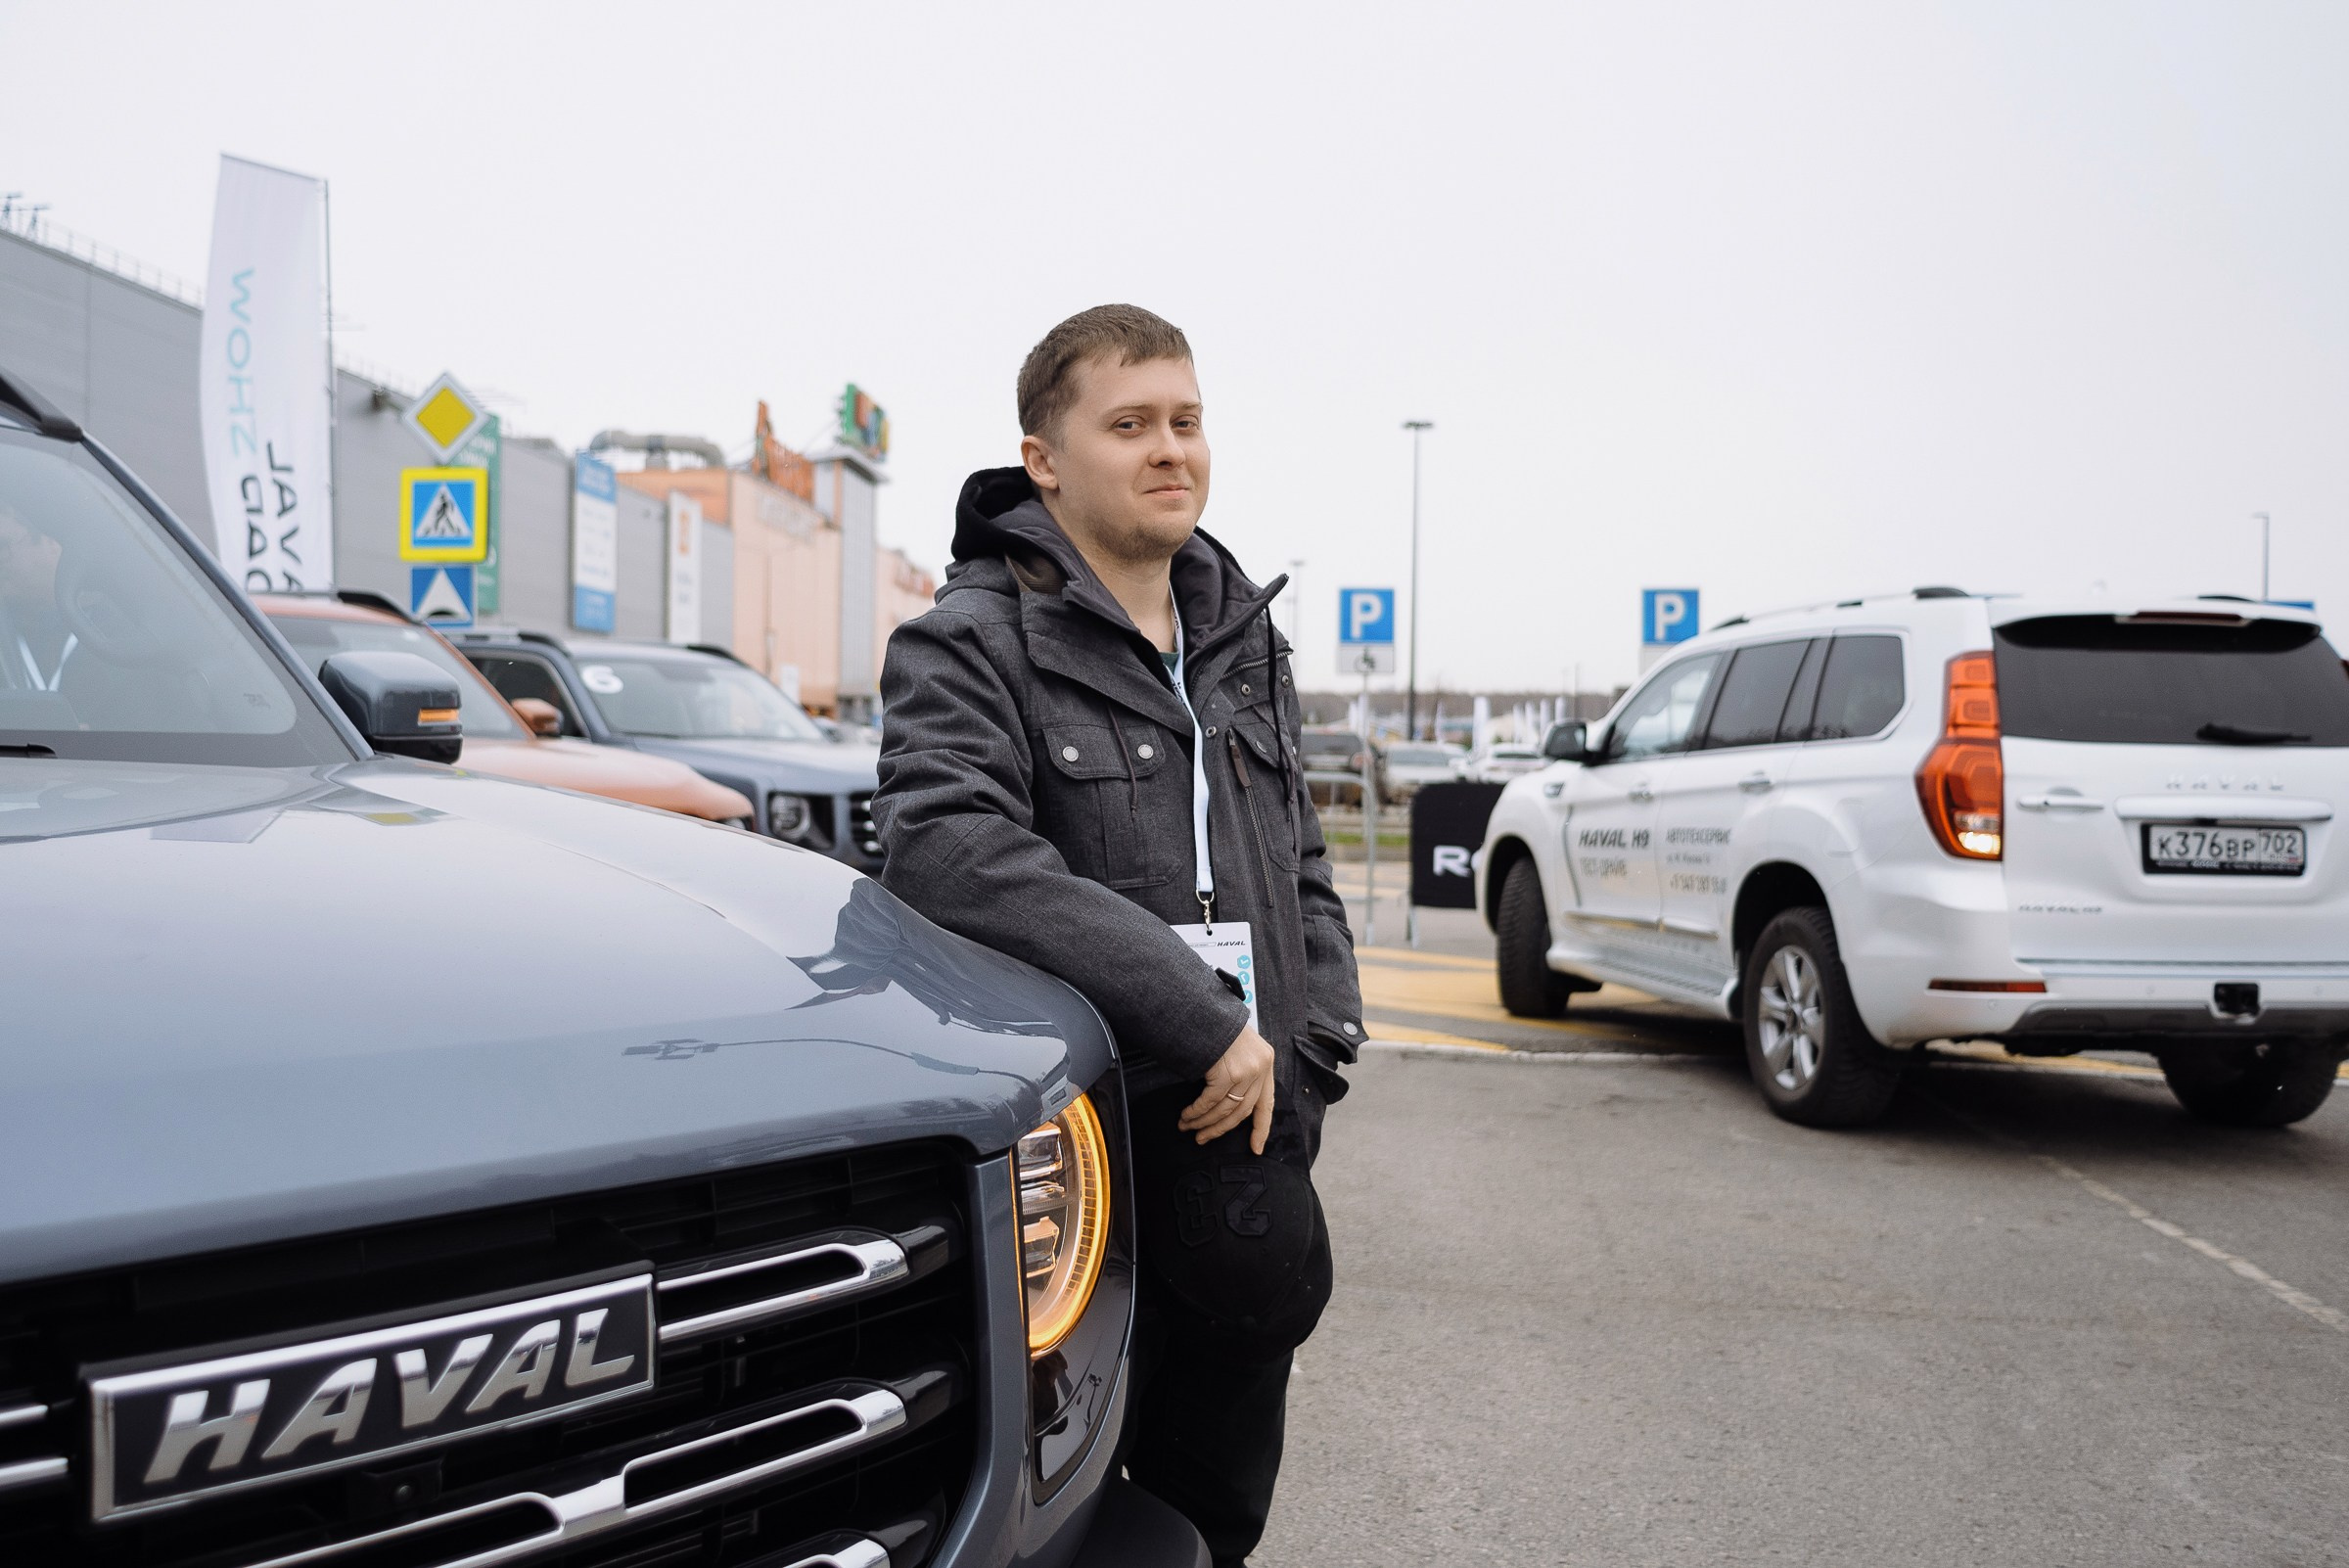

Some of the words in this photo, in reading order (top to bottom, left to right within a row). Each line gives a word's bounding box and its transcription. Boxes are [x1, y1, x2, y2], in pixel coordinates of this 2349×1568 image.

[1352, 593, 1382, 638] P
[1654, 593, 1684, 640] P
[1579, 828, 1627, 849] HAVAL
[1632, 827, 1651, 849] H9
[143, 1308, 635, 1484] HAVAL
